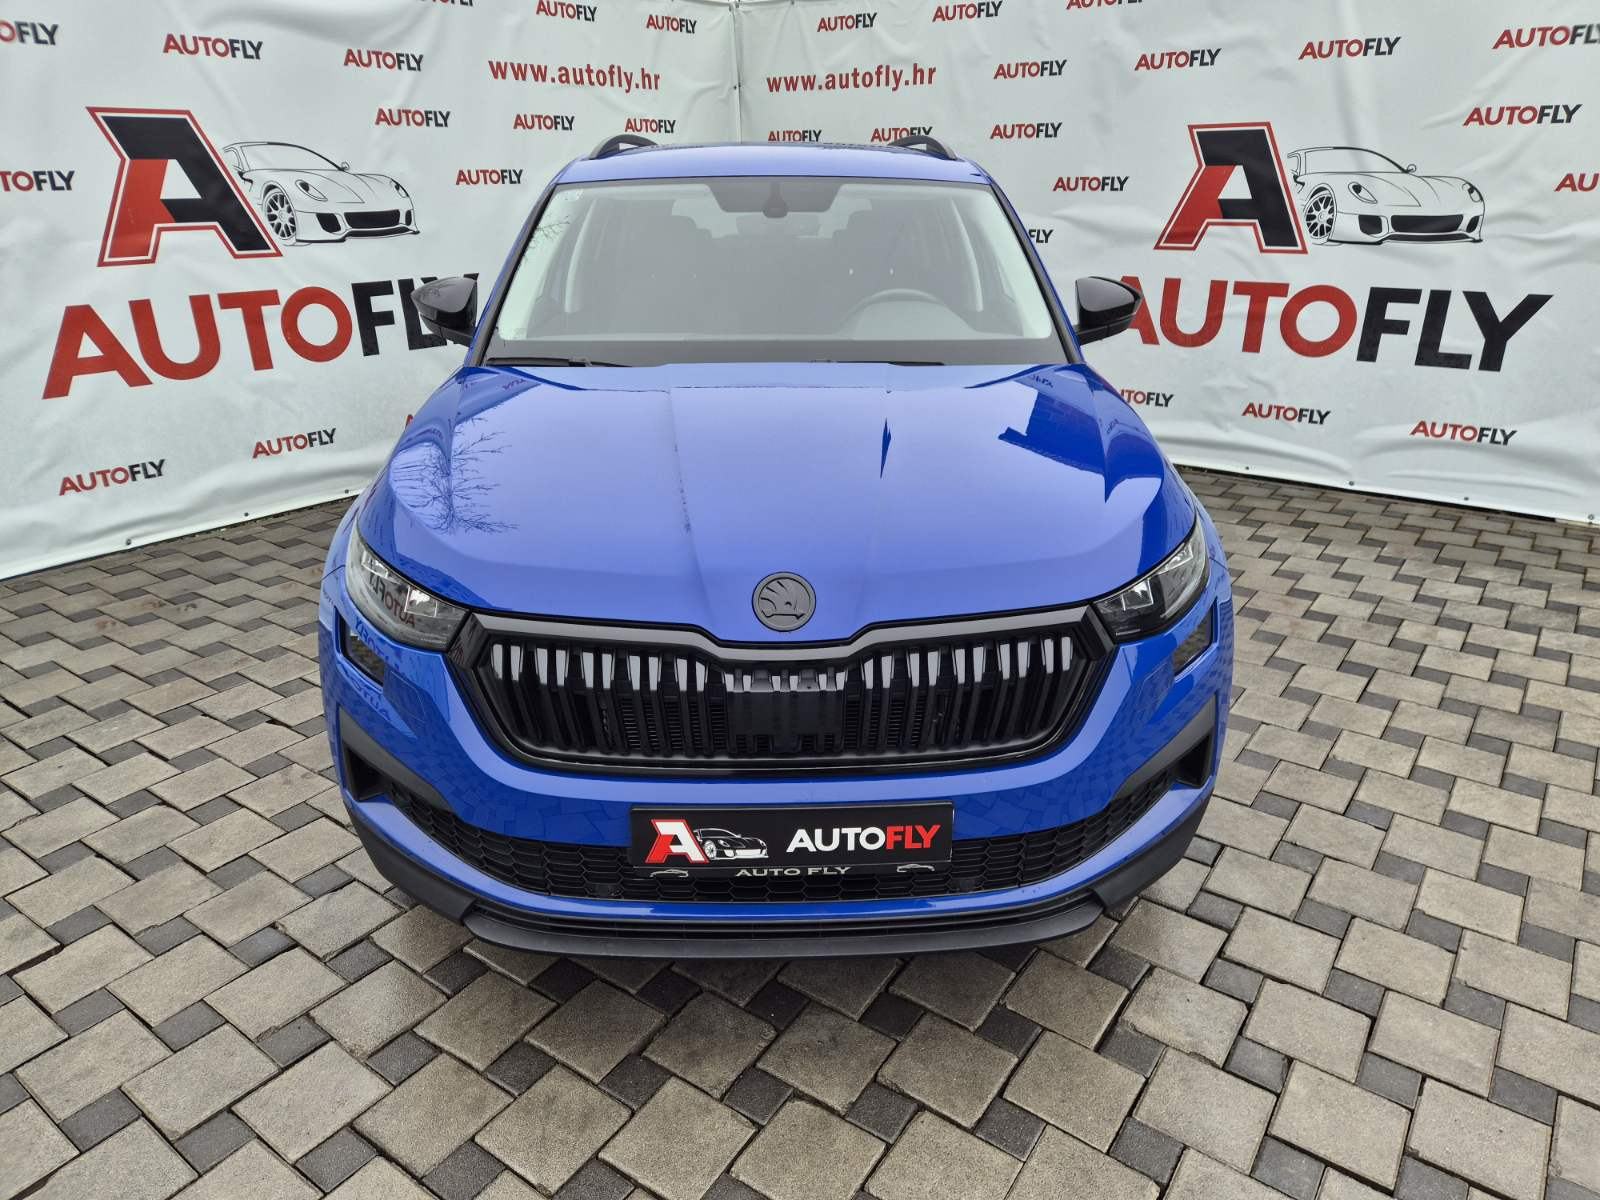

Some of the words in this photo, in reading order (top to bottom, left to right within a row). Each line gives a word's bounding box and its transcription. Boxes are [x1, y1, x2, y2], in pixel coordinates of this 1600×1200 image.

[536, 0, 597, 22] AUTOFLY
[817, 12, 877, 32] AUTOFLY
[932, 1, 1001, 22] AUTOFLY
[646, 14, 697, 34] AUTOFLY
[163, 34, 263, 60] AUTOFLY
[1298, 36, 1401, 60] AUTOFLY
[1492, 24, 1600, 49] AUTOFL
[344, 49, 424, 72] AUTOFLY
[994, 59, 1067, 80] AUTOFLY
[1135, 48, 1222, 71] AUTOFLY
[488, 60, 660, 93] www.autofly.hr
[767, 63, 936, 92] www.autofly.hr
[375, 108, 451, 128] AUTOFLY
[513, 114, 575, 131] AUTOFLY
[625, 118, 676, 134] AUTOFLY
[1463, 104, 1583, 127] AUTOFLY
[768, 129, 822, 142] AUTOFLY
[990, 122, 1062, 140] AUTOFLY
[456, 169, 523, 186] AUTOFLY
[1053, 176, 1129, 192] AUTOFLY
[42, 273, 479, 399] AUTOFL
[1242, 402, 1331, 425] AUTOFLY
[253, 428, 336, 458] AUTOFLY
[1410, 421, 1517, 446] AUTOFLY
[59, 459, 165, 496] AUTOFLY
[786, 824, 941, 853] AUTOFLY
[736, 868, 801, 877] AUTO
[807, 866, 851, 875] FLY
